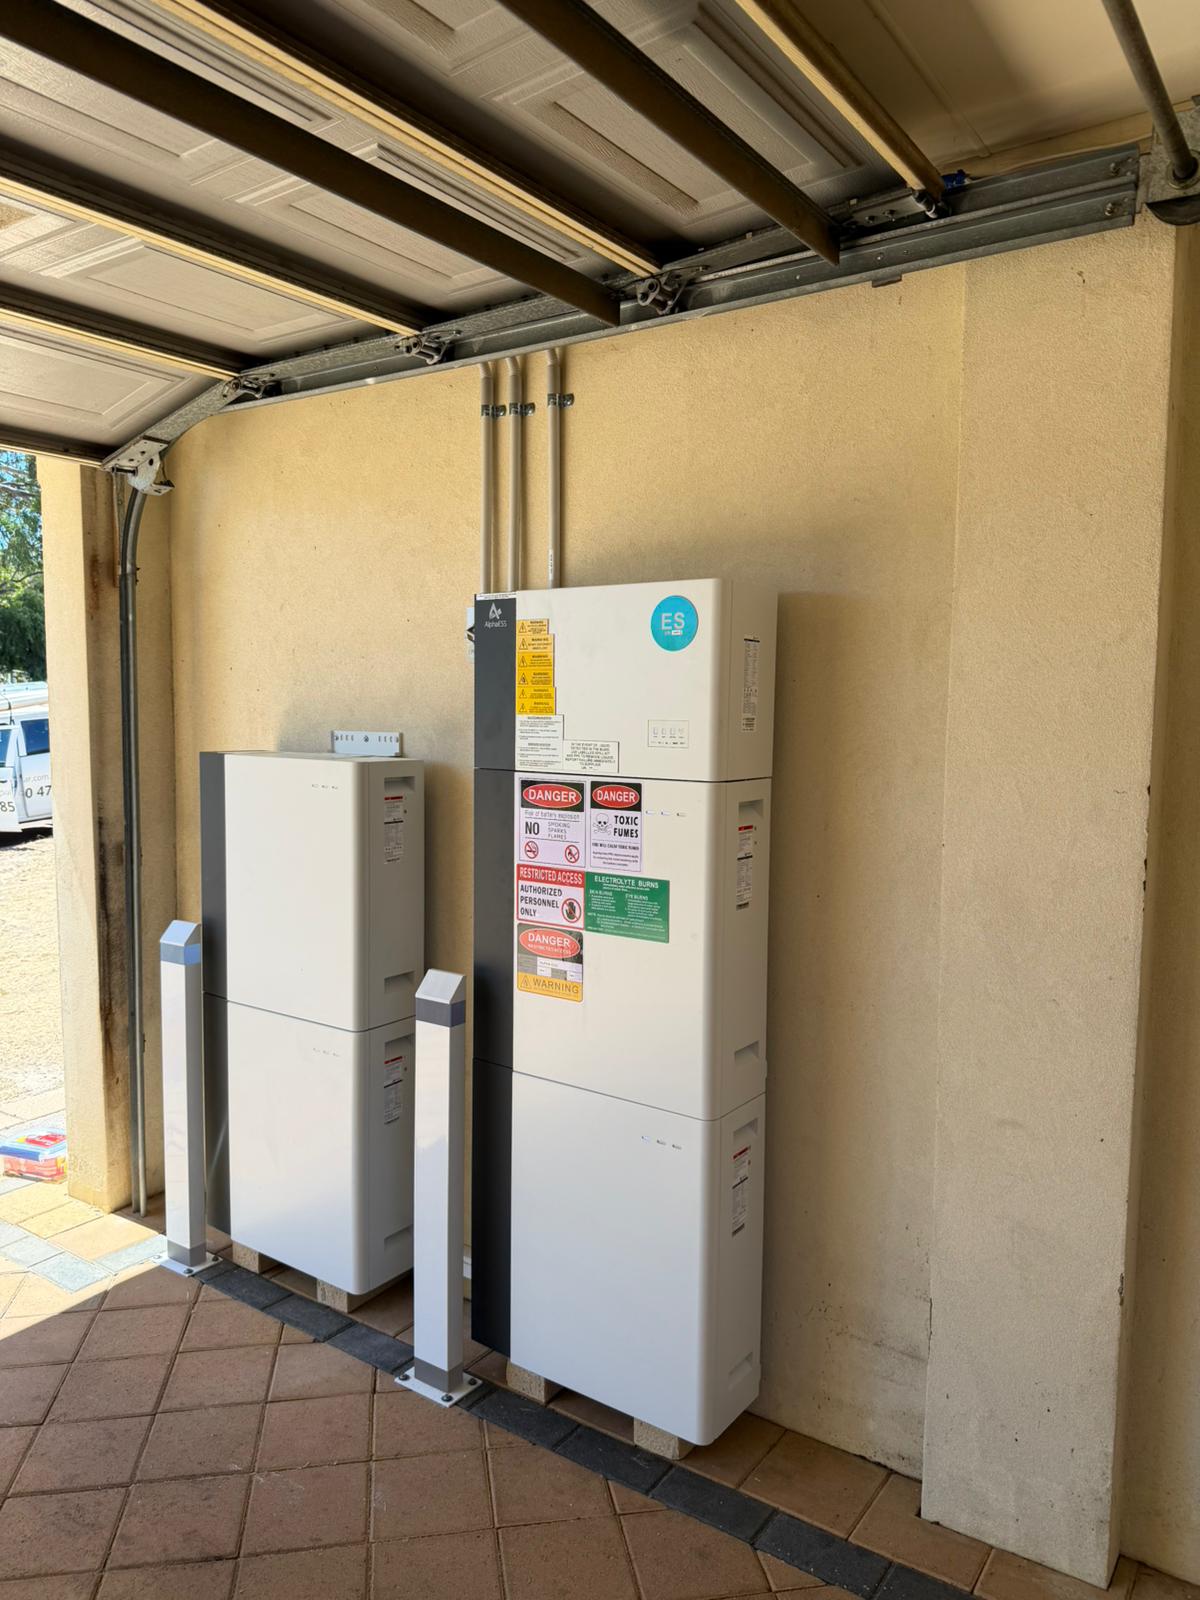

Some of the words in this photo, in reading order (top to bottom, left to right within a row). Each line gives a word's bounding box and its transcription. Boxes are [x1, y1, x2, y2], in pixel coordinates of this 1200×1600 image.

[484, 620, 508, 629] AlphaESS
[661, 612, 685, 630] ES
[528, 789, 577, 803] DANGER
[597, 789, 636, 803] DANGER
[614, 815, 639, 826] TOXIC
[525, 821, 540, 835] NO
[613, 828, 639, 838] FUMES
[519, 867, 556, 881] RESTRICTED
[557, 870, 583, 884] ACCESS
[594, 875, 635, 886] ELECTROLYTE
[638, 880, 659, 889] BURNS
[520, 884, 563, 897] AUTHORIZED
[520, 895, 560, 909] PERSONNEL
[520, 907, 537, 917] ONLY
[527, 932, 571, 947] DANGER
[532, 977, 579, 994] WARNING
